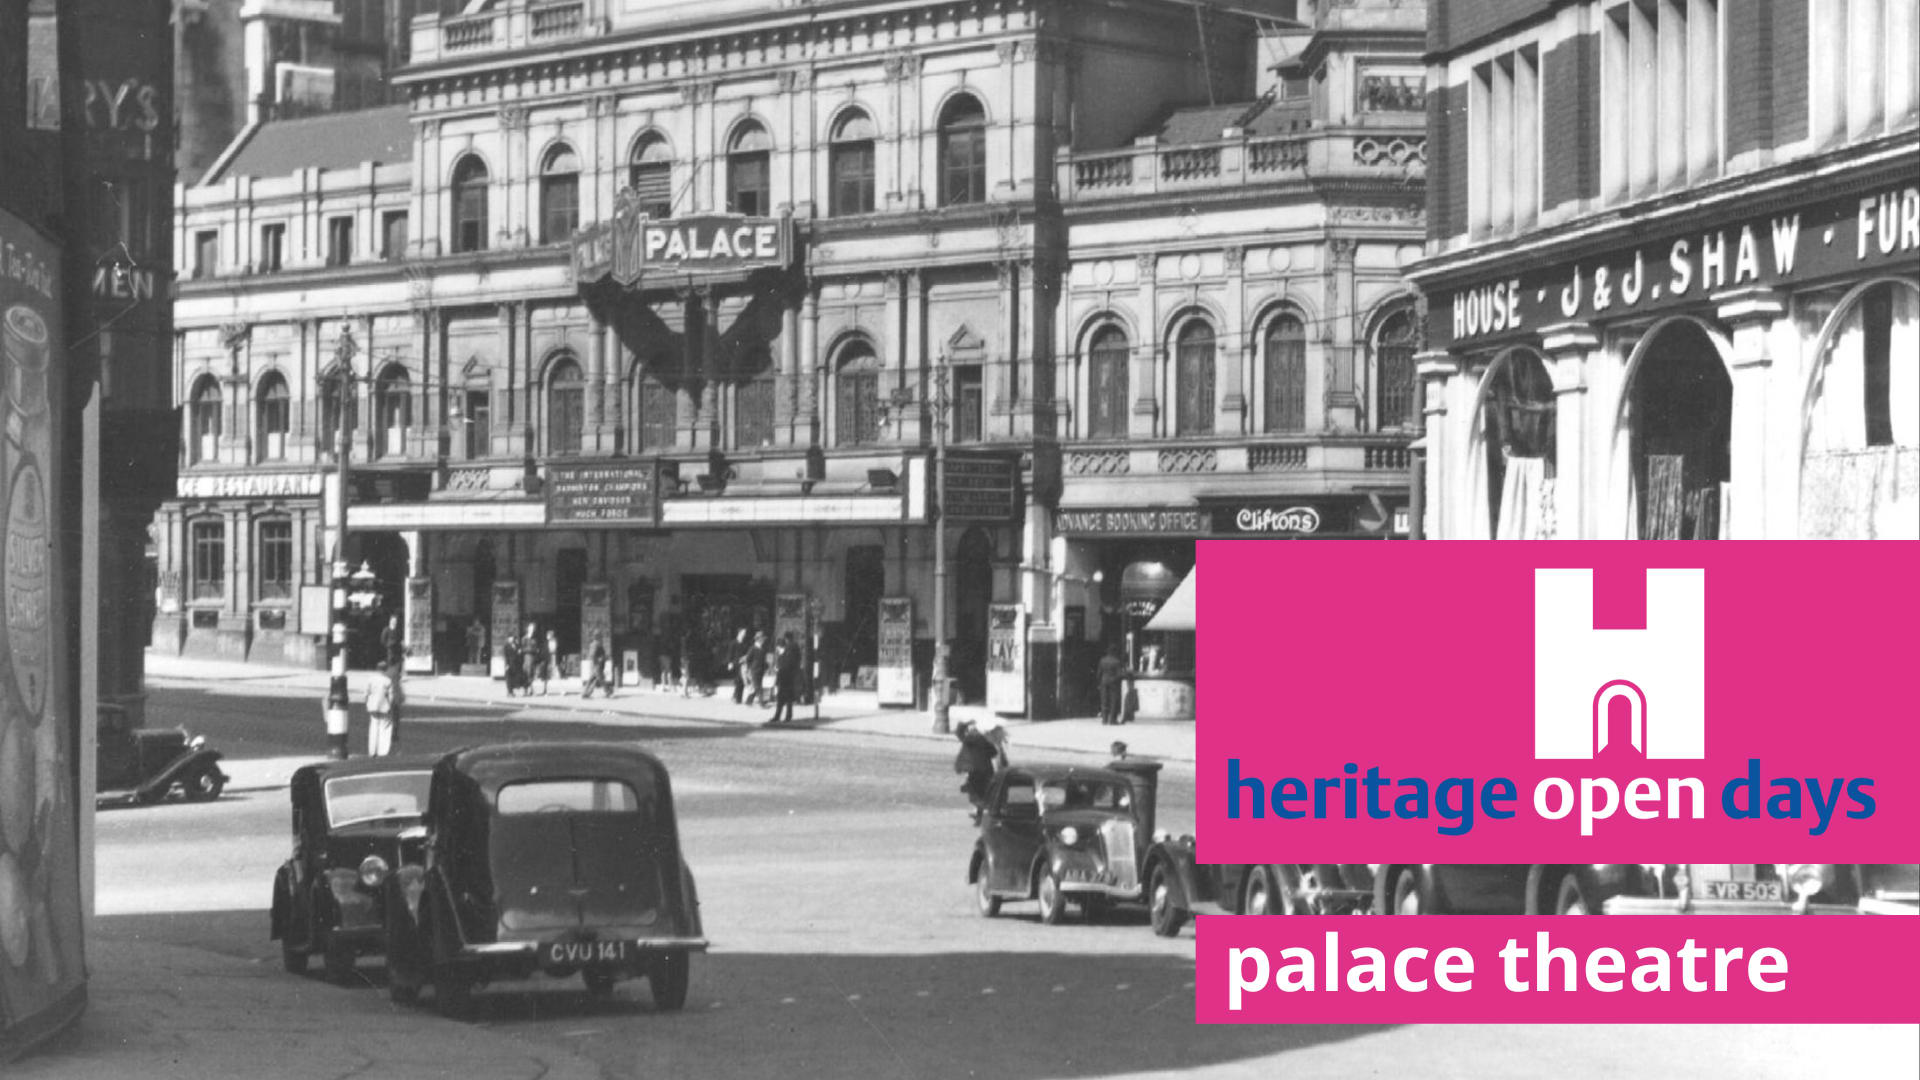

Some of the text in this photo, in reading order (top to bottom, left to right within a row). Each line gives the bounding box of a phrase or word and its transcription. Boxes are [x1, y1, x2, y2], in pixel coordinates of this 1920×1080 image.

[646, 225, 777, 260] PALACE
[1453, 279, 1522, 340] HOUSE
[1669, 213, 1799, 295] SHAW
[213, 474, 321, 496] RESTAURANT
[561, 471, 575, 479] THE
[1057, 511, 1198, 530] ADVANCE BOOKING OFFICE
[1237, 507, 1320, 532] Cliftons
[1702, 882, 1778, 900] EVR 503
[551, 942, 625, 961] CVU 141
